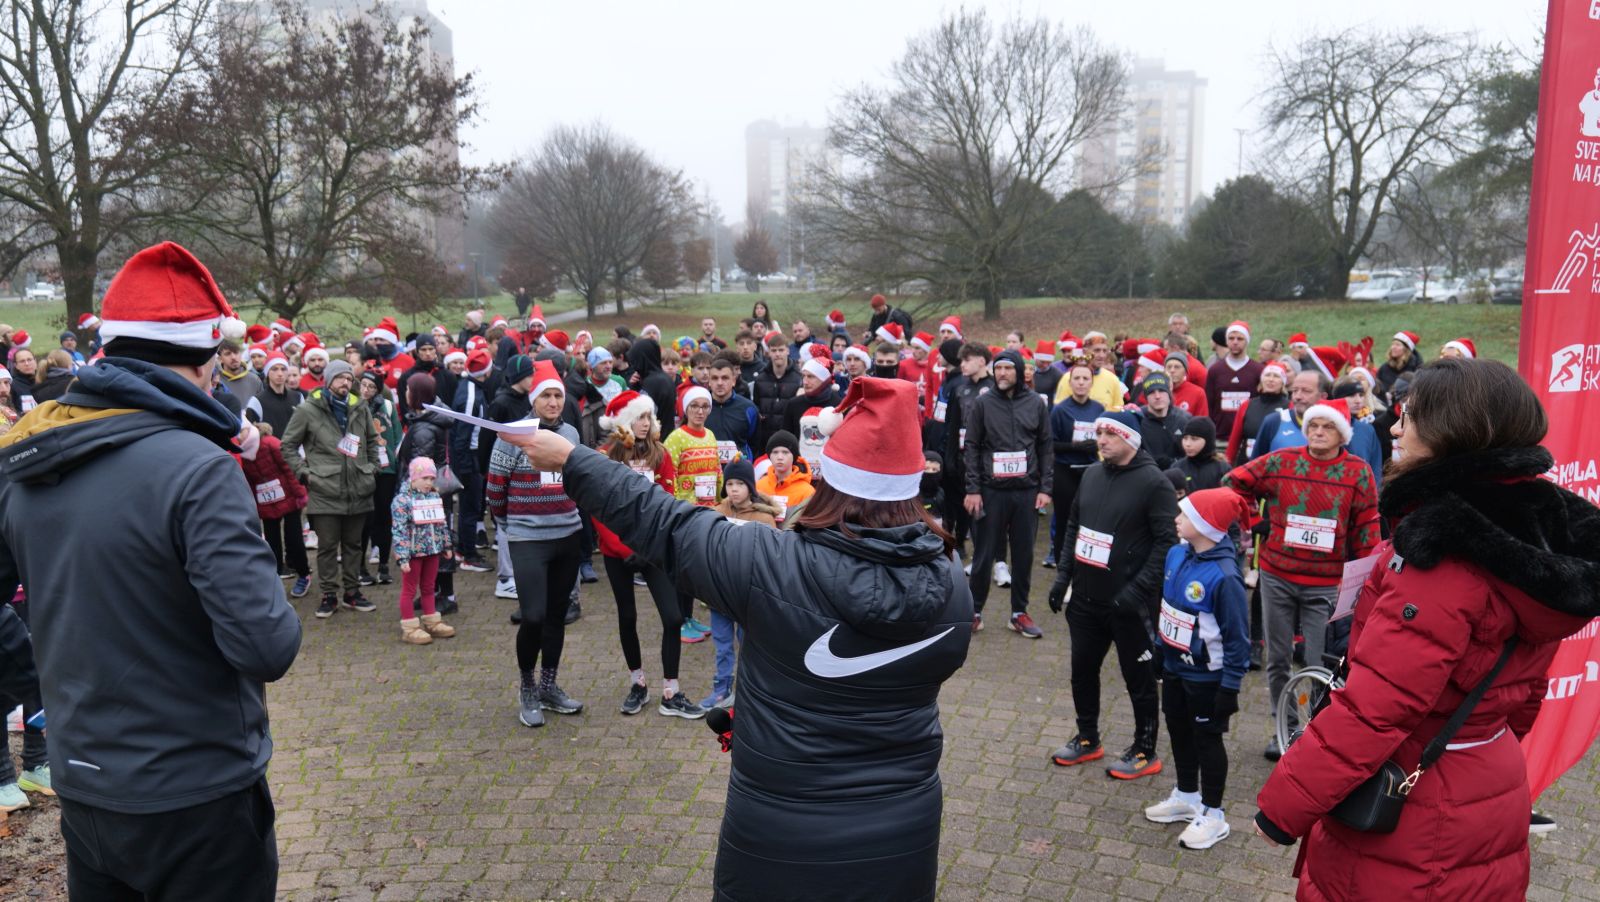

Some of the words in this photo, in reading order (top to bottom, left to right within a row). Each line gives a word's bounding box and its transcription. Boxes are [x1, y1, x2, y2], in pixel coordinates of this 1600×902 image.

[1002, 462, 1020, 473] 167
[262, 490, 277, 501] 137
[421, 509, 437, 520] 141
[1301, 530, 1319, 545] 46
[1082, 543, 1094, 558] 41
[1163, 619, 1179, 641] 101
